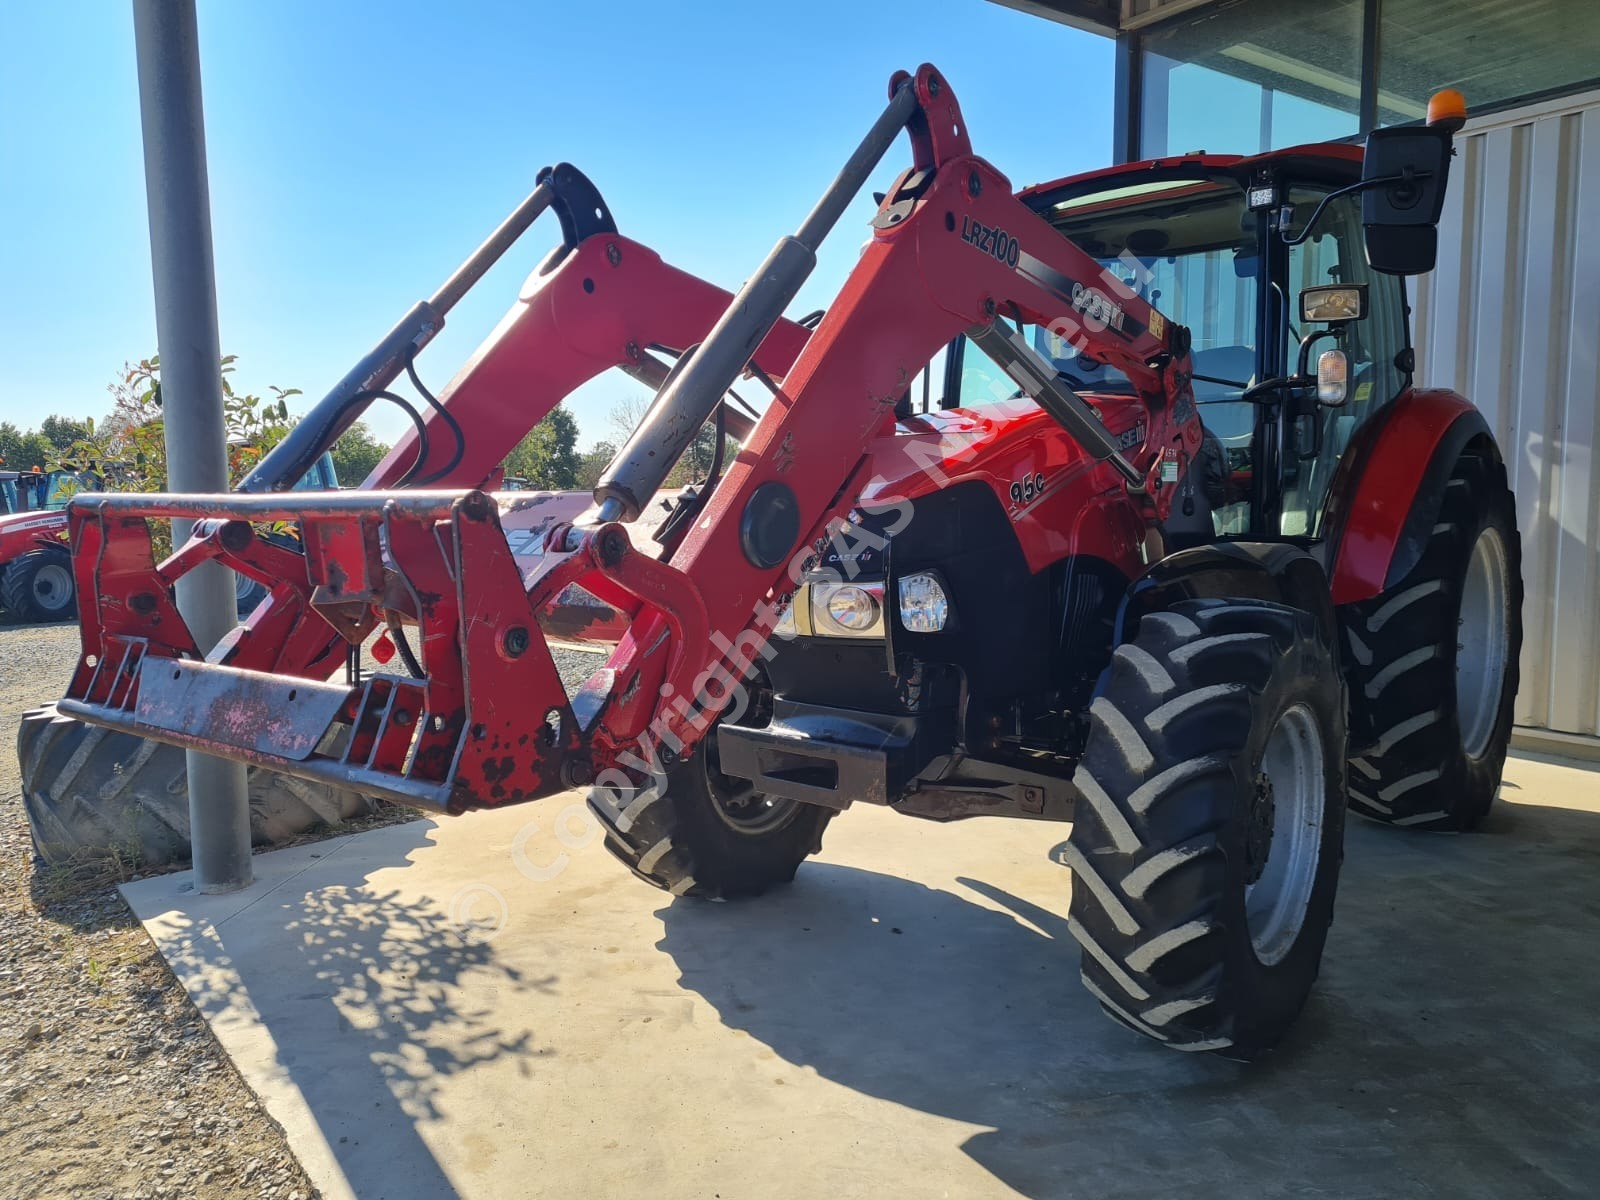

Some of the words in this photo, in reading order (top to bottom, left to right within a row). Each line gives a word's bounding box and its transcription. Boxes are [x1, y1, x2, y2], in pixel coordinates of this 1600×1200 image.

[961, 214, 1019, 269] LRZ100
[1072, 282, 1111, 324] CASE
[829, 554, 859, 562] CASE
